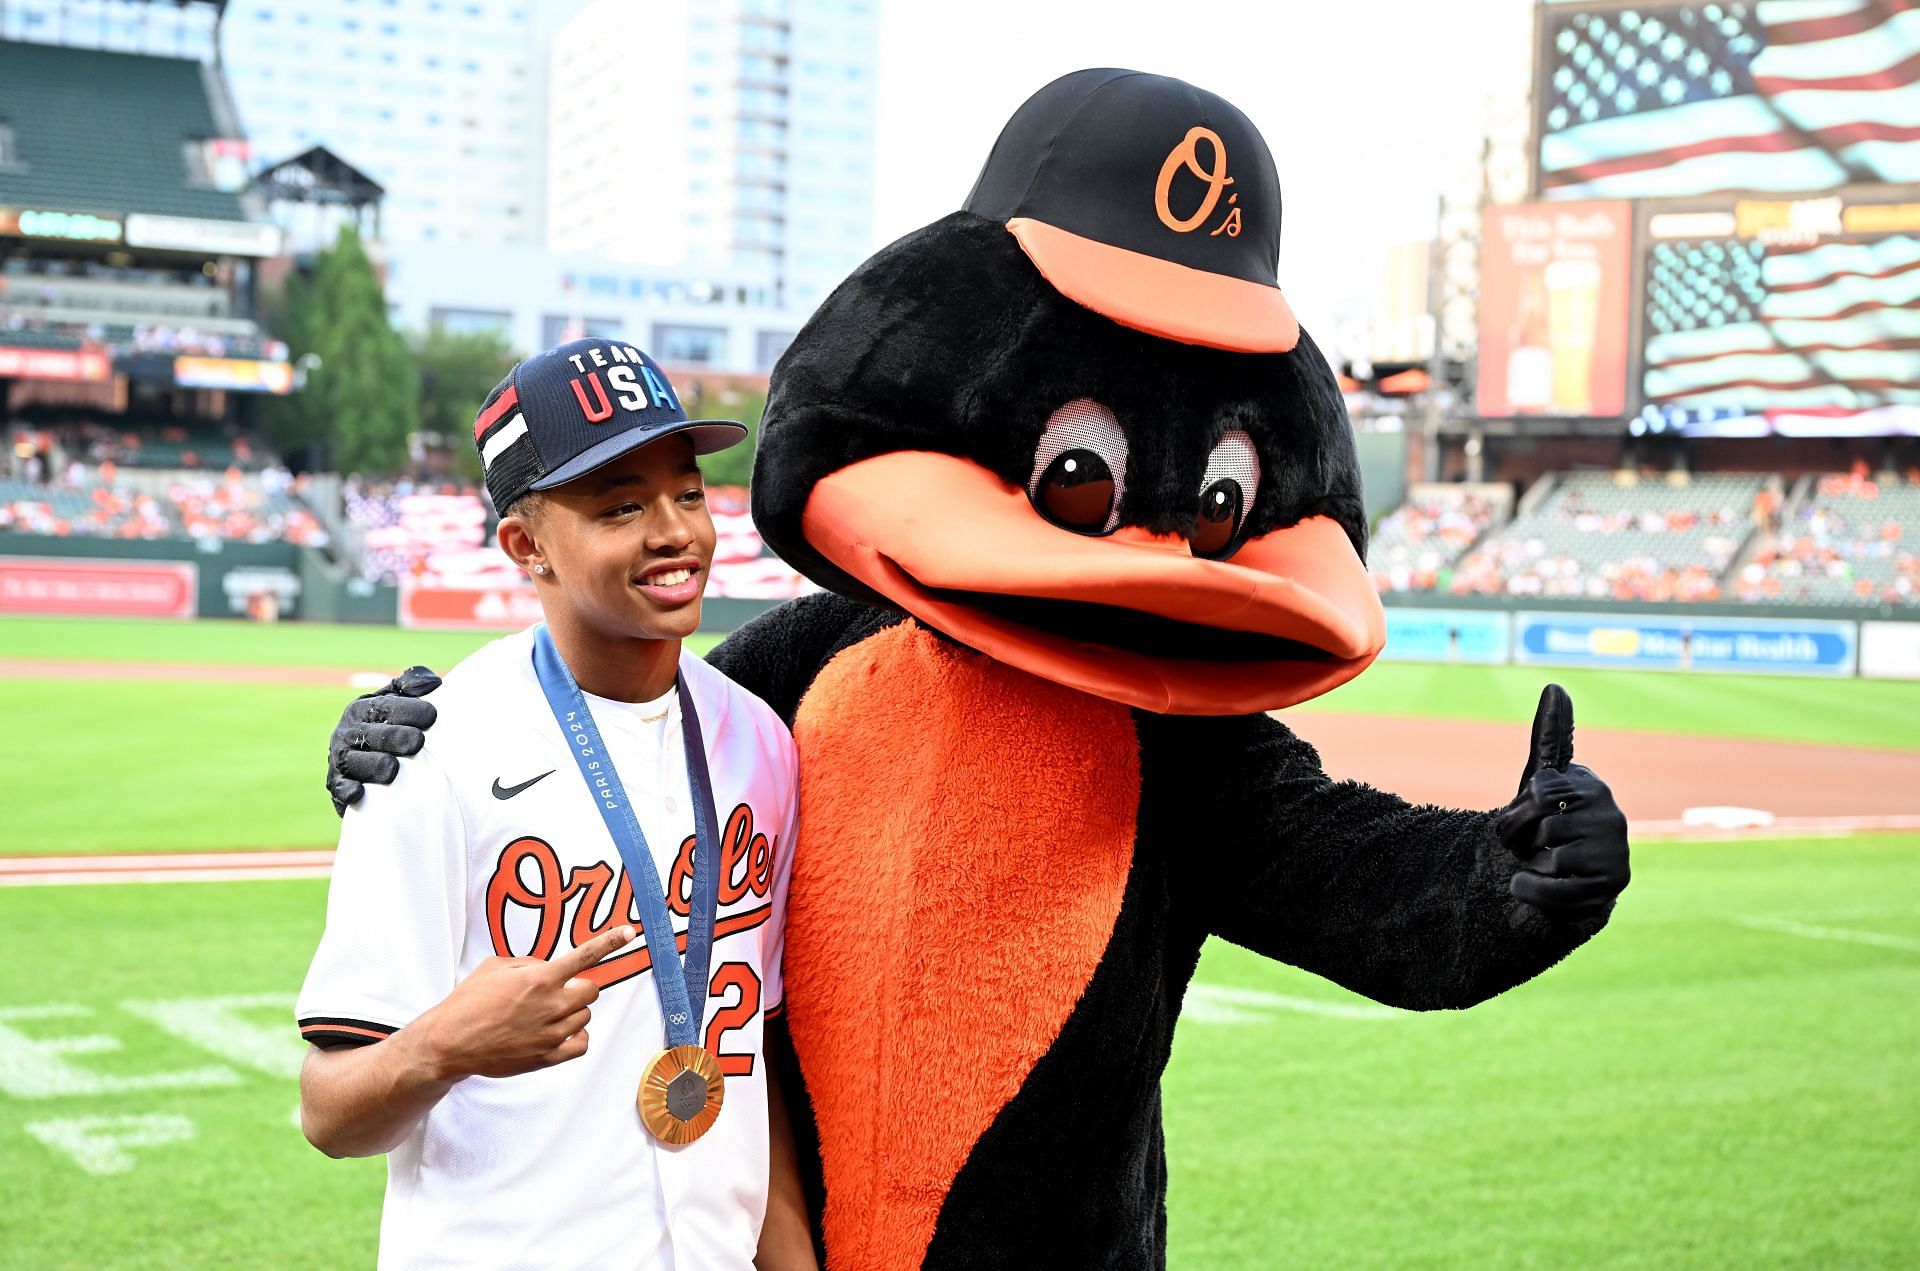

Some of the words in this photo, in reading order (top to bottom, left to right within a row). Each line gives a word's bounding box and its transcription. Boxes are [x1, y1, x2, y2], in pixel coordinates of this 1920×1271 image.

[1154, 126, 1243, 238] O's
[568, 345, 644, 373] TEAM
[570, 364, 677, 424] USA
[566, 711, 595, 757] 2024
[588, 761, 618, 809] PARIS
[704, 962, 761, 1077] 2
